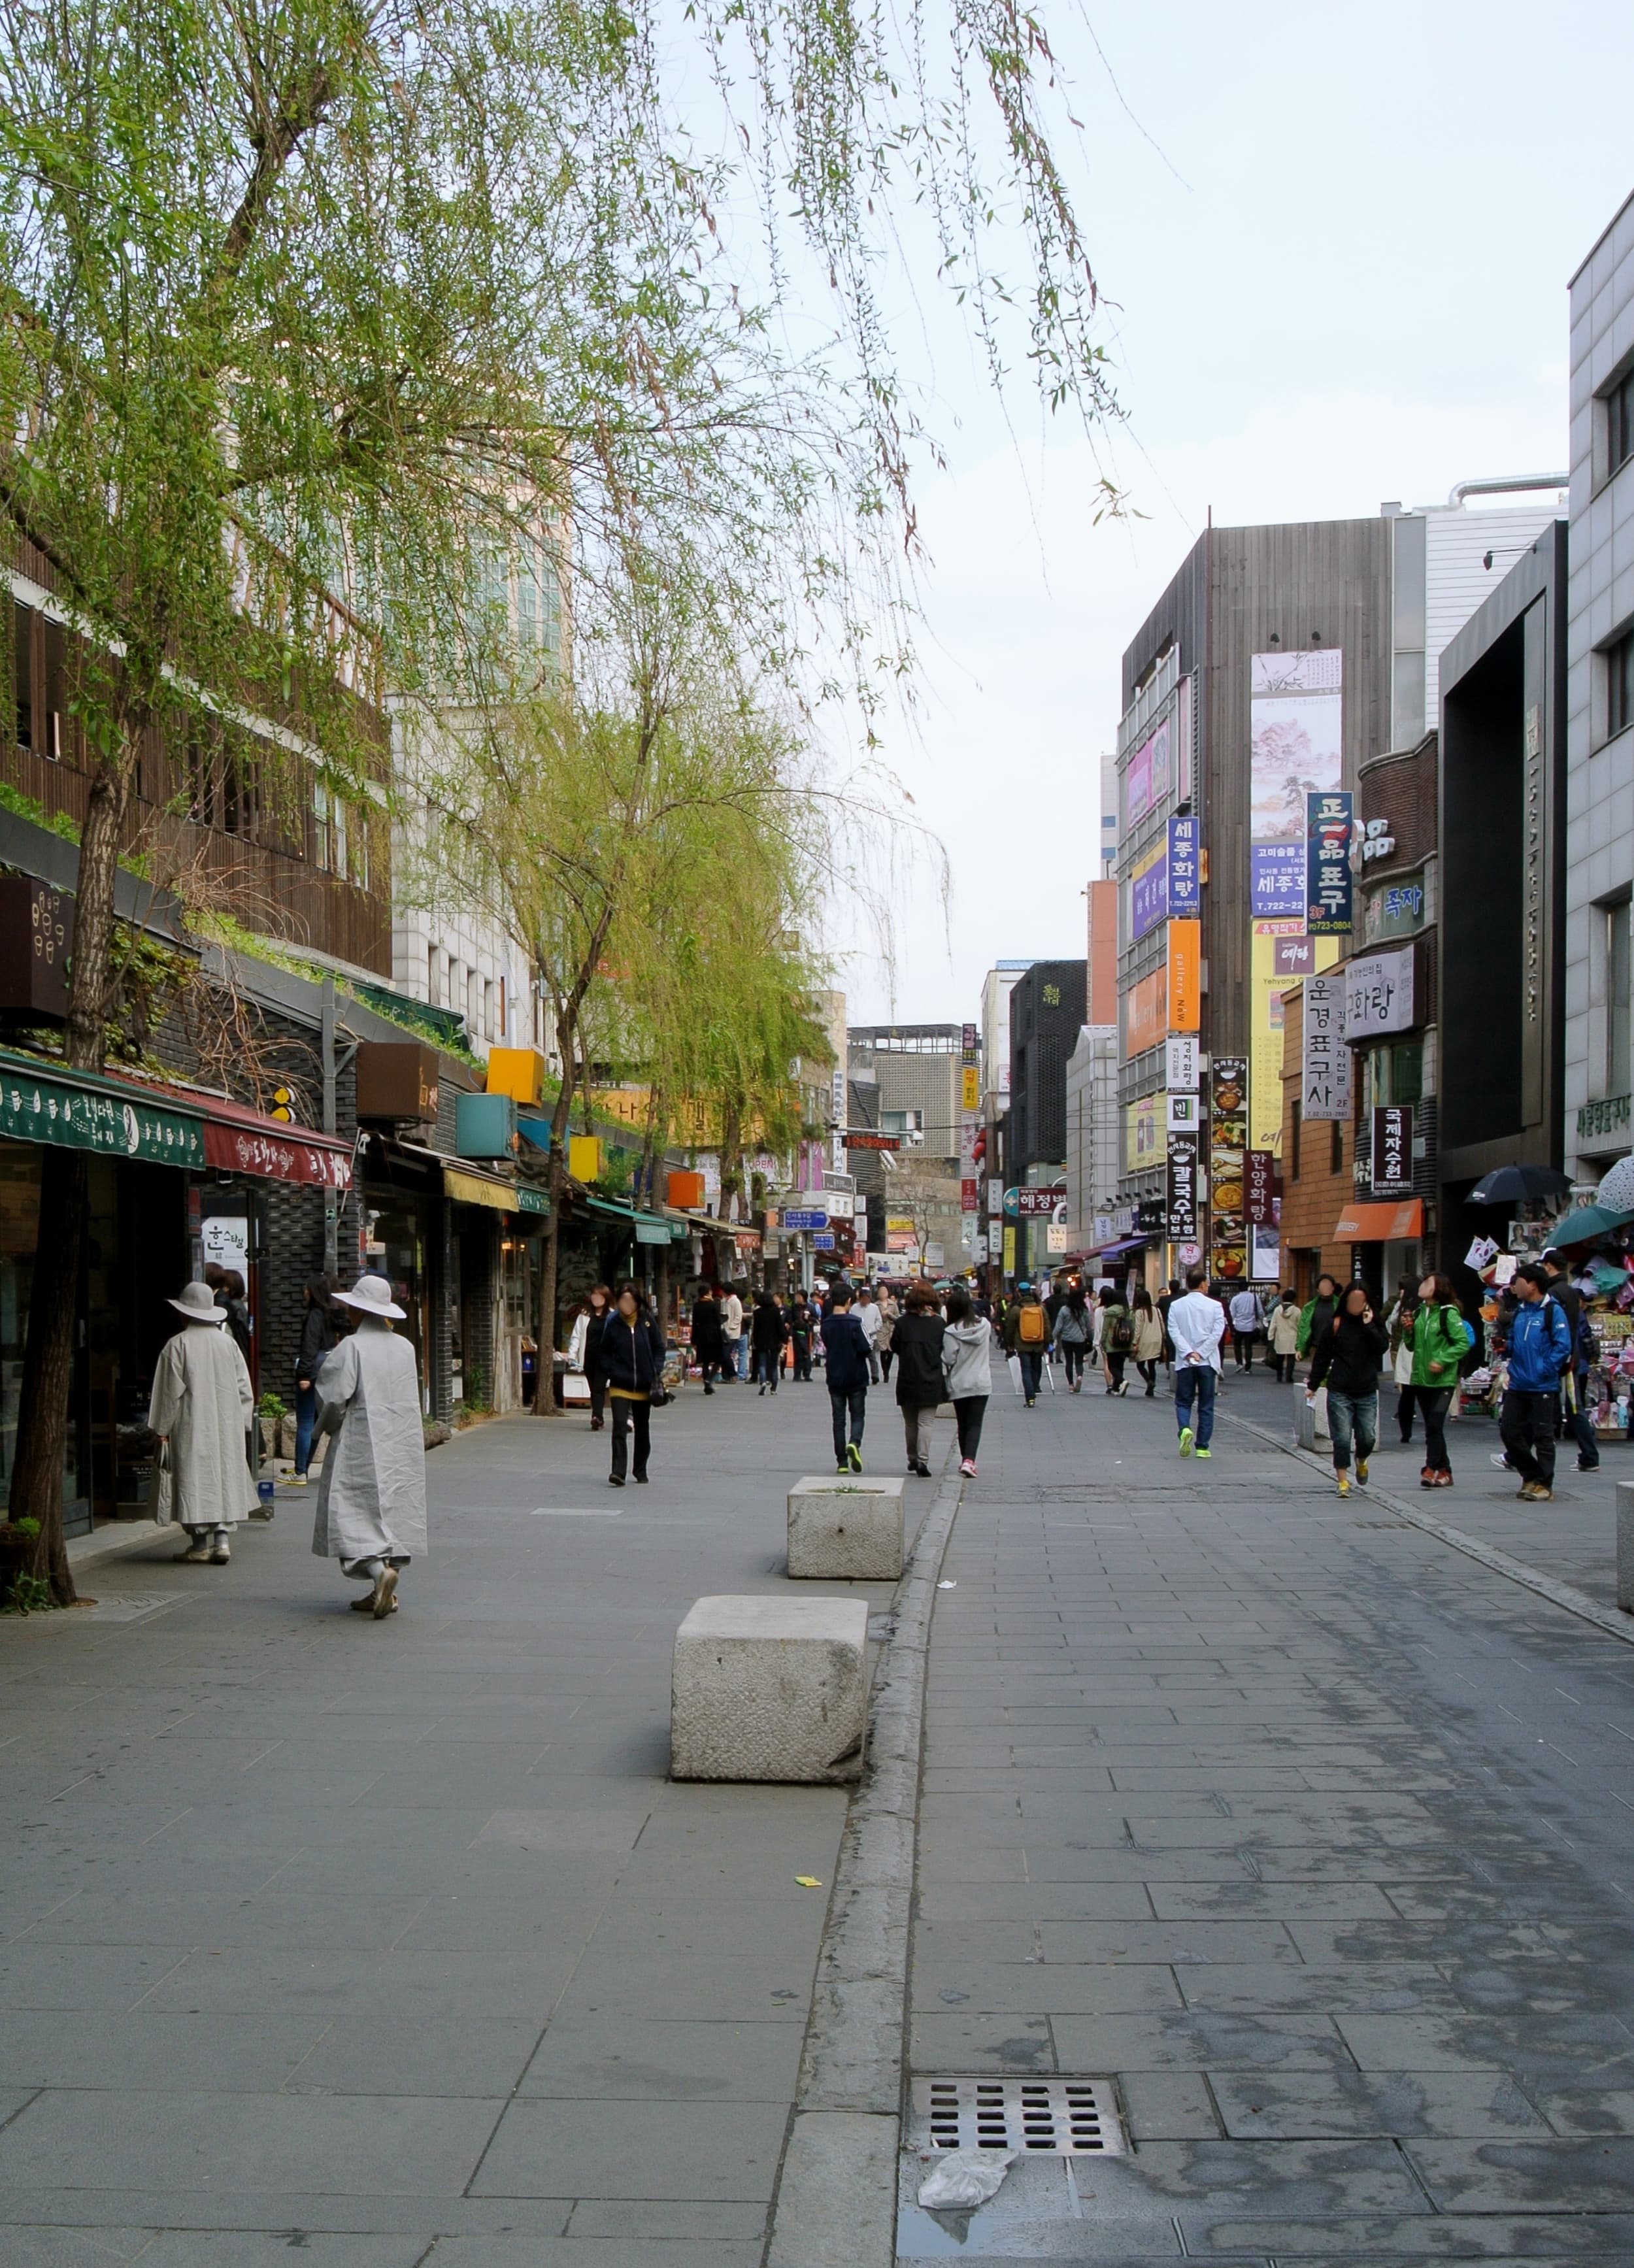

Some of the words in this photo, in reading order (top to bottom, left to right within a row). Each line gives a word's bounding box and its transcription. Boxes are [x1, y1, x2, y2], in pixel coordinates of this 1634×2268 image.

[1172, 821, 1195, 897] 세종화랑
[1309, 905, 1326, 920] 3F
[1384, 884, 1422, 919] 족자
[1175, 953, 1186, 995] gallery
[1308, 980, 1333, 1107] 운경표구사
[1384, 1109, 1402, 1179] 국제자수원
[1173, 1166, 1192, 1214] 칼국수
[1250, 1154, 1269, 1222] 한양화랑
[1169, 1214, 1193, 1224] 만두
[1170, 1224, 1194, 1234] 보쌈
